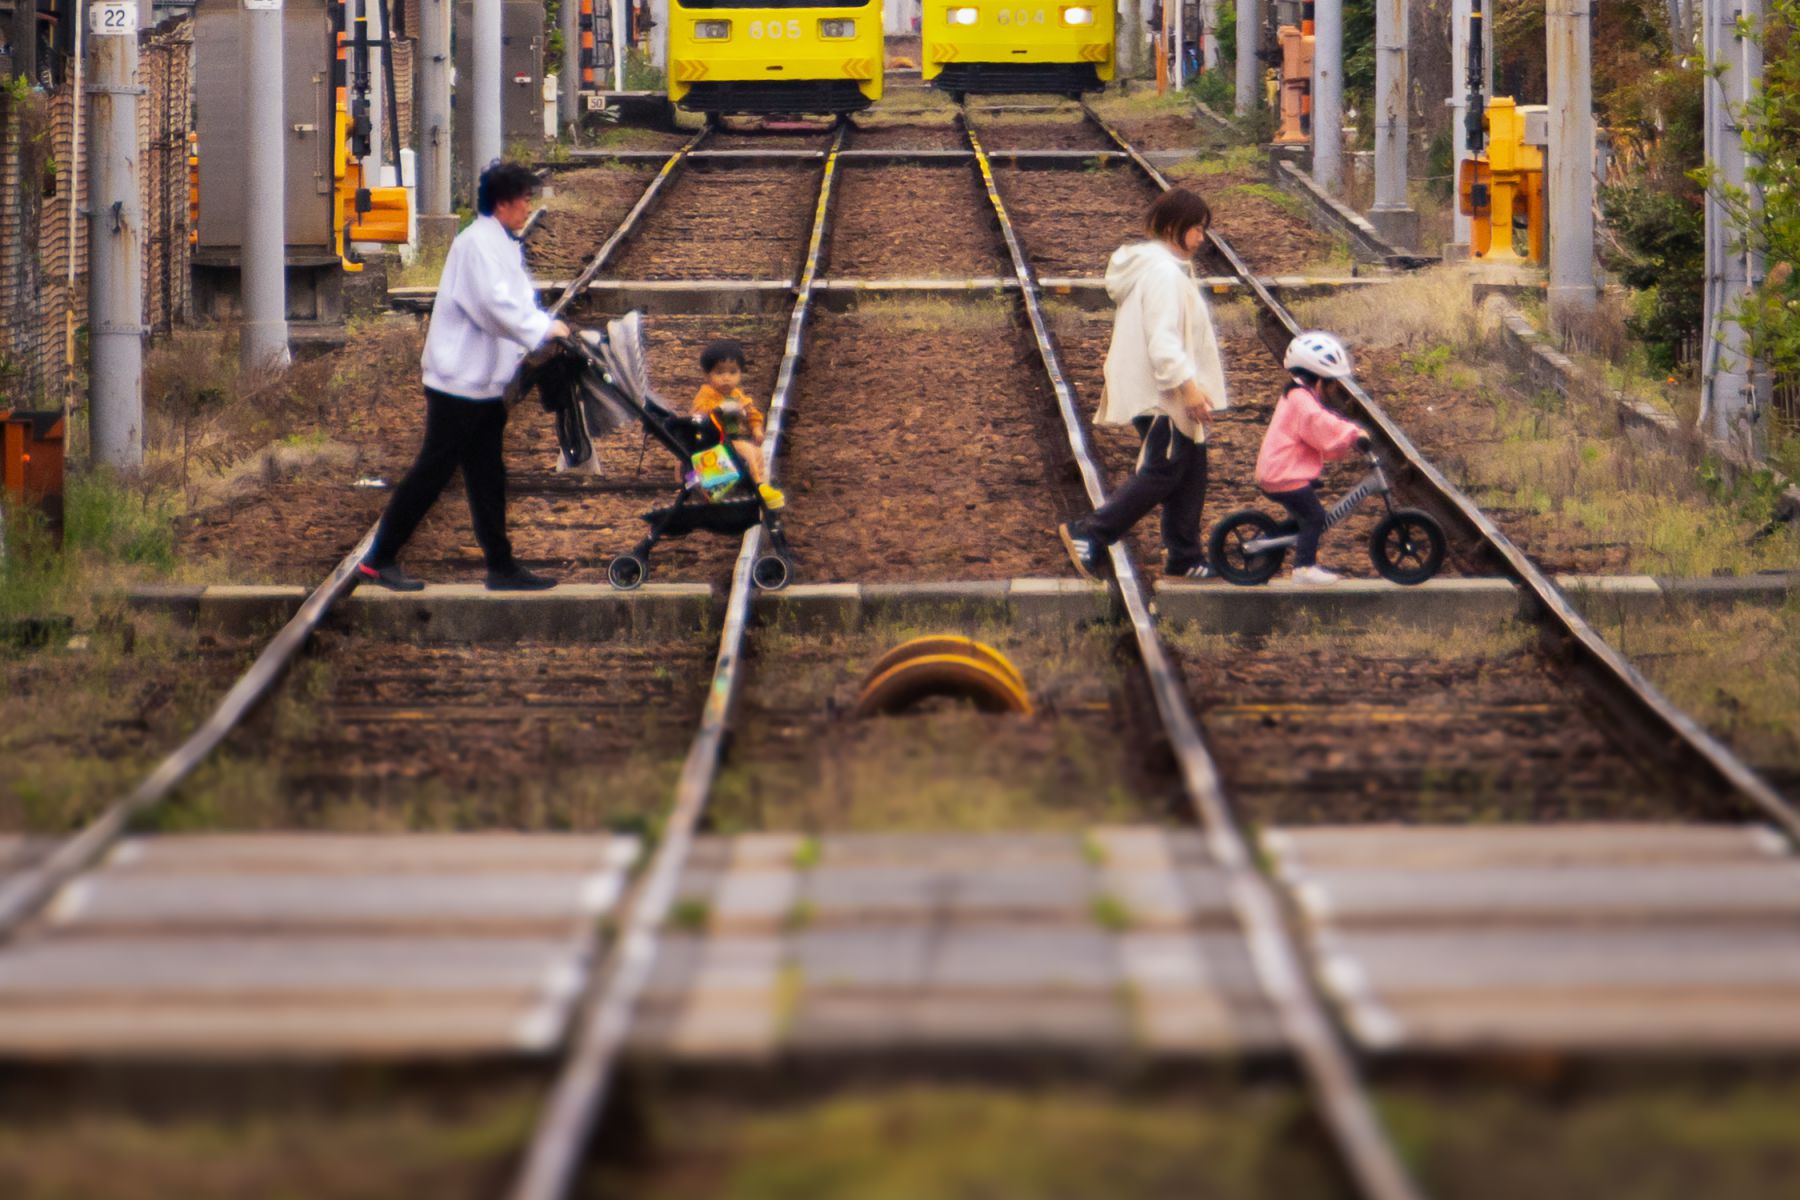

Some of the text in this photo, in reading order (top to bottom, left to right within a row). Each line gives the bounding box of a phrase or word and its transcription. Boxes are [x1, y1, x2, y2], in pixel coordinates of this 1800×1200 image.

[104, 9, 125, 27] 22
[997, 8, 1045, 26] 604
[749, 20, 801, 39] 605
